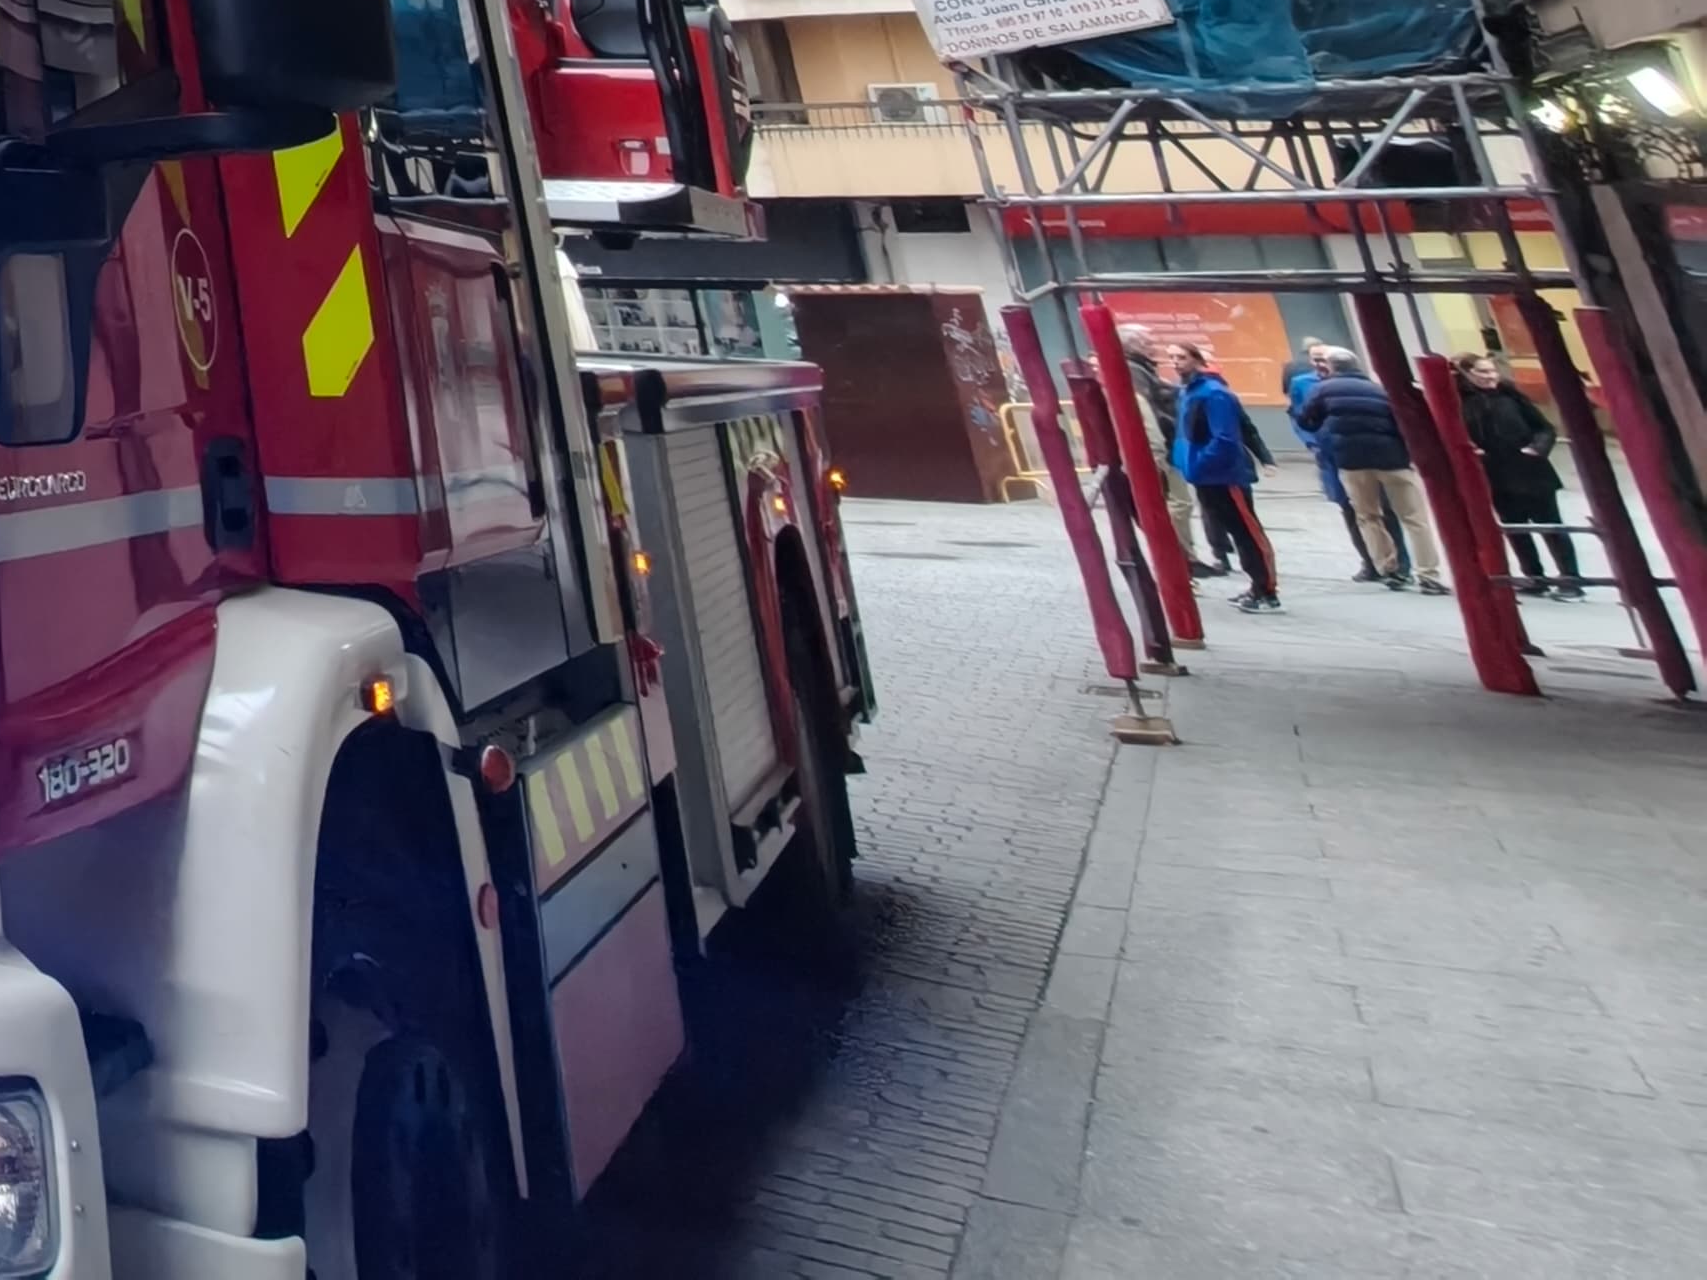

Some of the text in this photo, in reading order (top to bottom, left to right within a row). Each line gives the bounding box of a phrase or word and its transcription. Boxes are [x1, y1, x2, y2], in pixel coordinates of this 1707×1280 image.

[981, 3, 1020, 17] Juan
[1022, 26, 1046, 40] DE
[1048, 8, 1151, 35] SALAMANCA
[38, 738, 130, 804] 180-320
